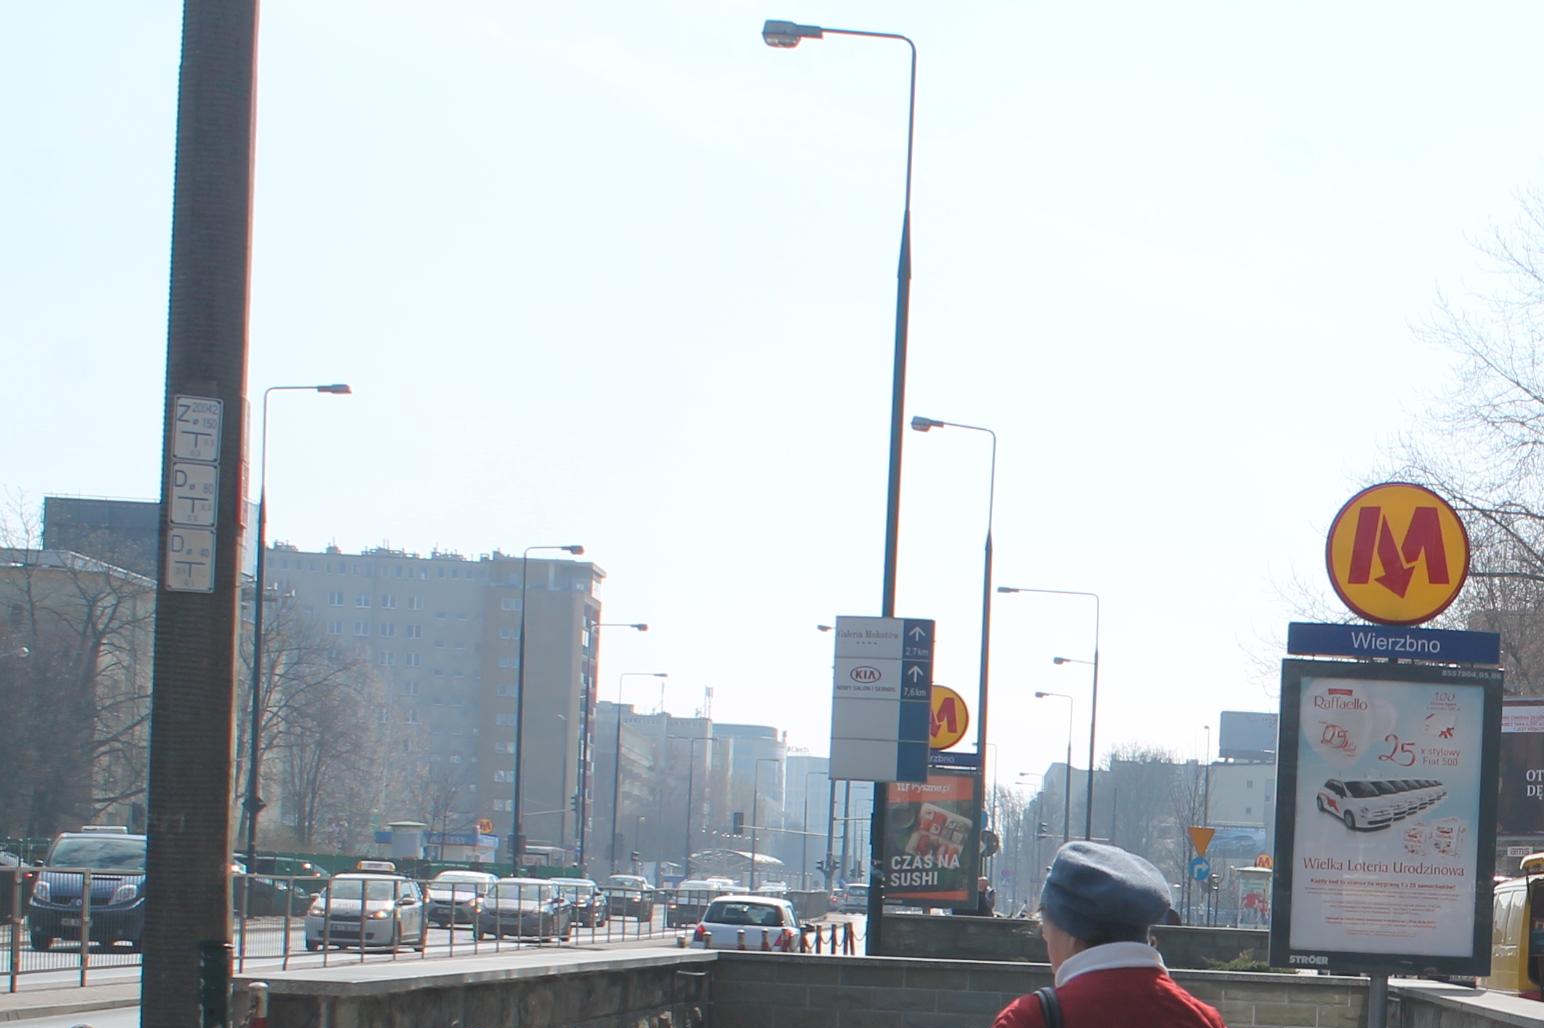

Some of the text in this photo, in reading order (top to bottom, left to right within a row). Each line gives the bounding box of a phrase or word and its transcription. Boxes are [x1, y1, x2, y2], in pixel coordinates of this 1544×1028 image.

[178, 404, 191, 423] Z
[175, 469, 187, 487] D
[172, 535, 184, 552] D
[1351, 632, 1441, 654] Wierzbno
[855, 670, 876, 680] KIA
[1313, 695, 1368, 711] Raffaello
[1378, 733, 1416, 767] 25
[1428, 747, 1461, 758] stylowy
[1423, 758, 1458, 767] Fiat 500
[891, 854, 961, 870] CZAS NA
[1303, 857, 1464, 877] Wielka Loteria Urodzinowa
[890, 871, 938, 887] SUSHI
